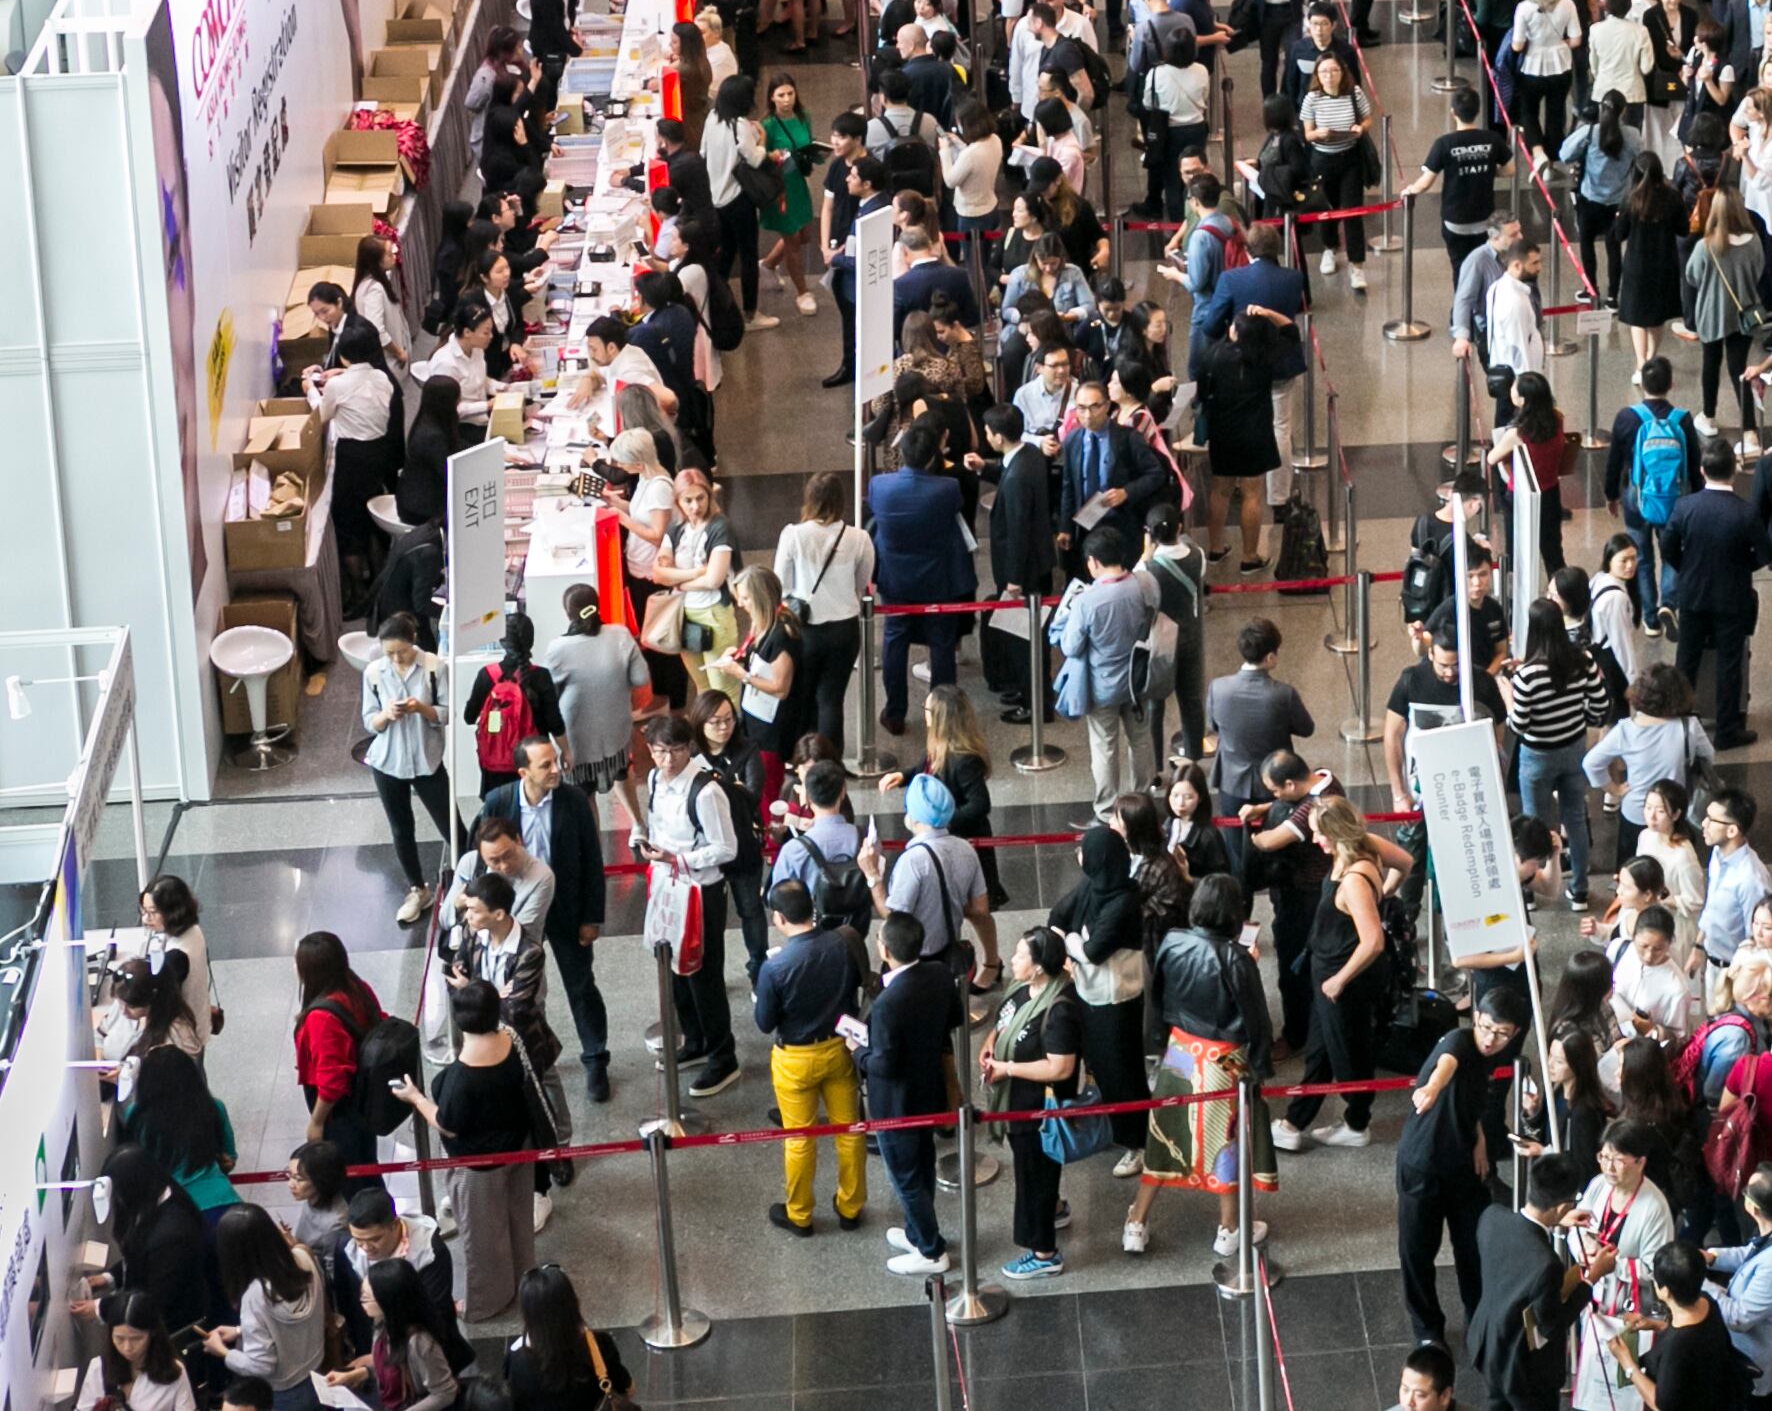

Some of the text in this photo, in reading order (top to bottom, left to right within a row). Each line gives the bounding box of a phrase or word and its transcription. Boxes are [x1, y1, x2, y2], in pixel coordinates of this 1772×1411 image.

[1459, 165, 1489, 176] STAFF
[868, 249, 878, 286] EXIT
[464, 487, 479, 528] EXIT
[483, 480, 496, 520] 出口
[1433, 772, 1451, 822] Counter
[1451, 769, 1468, 822] e-Badge
[1463, 825, 1482, 899] Redemption
